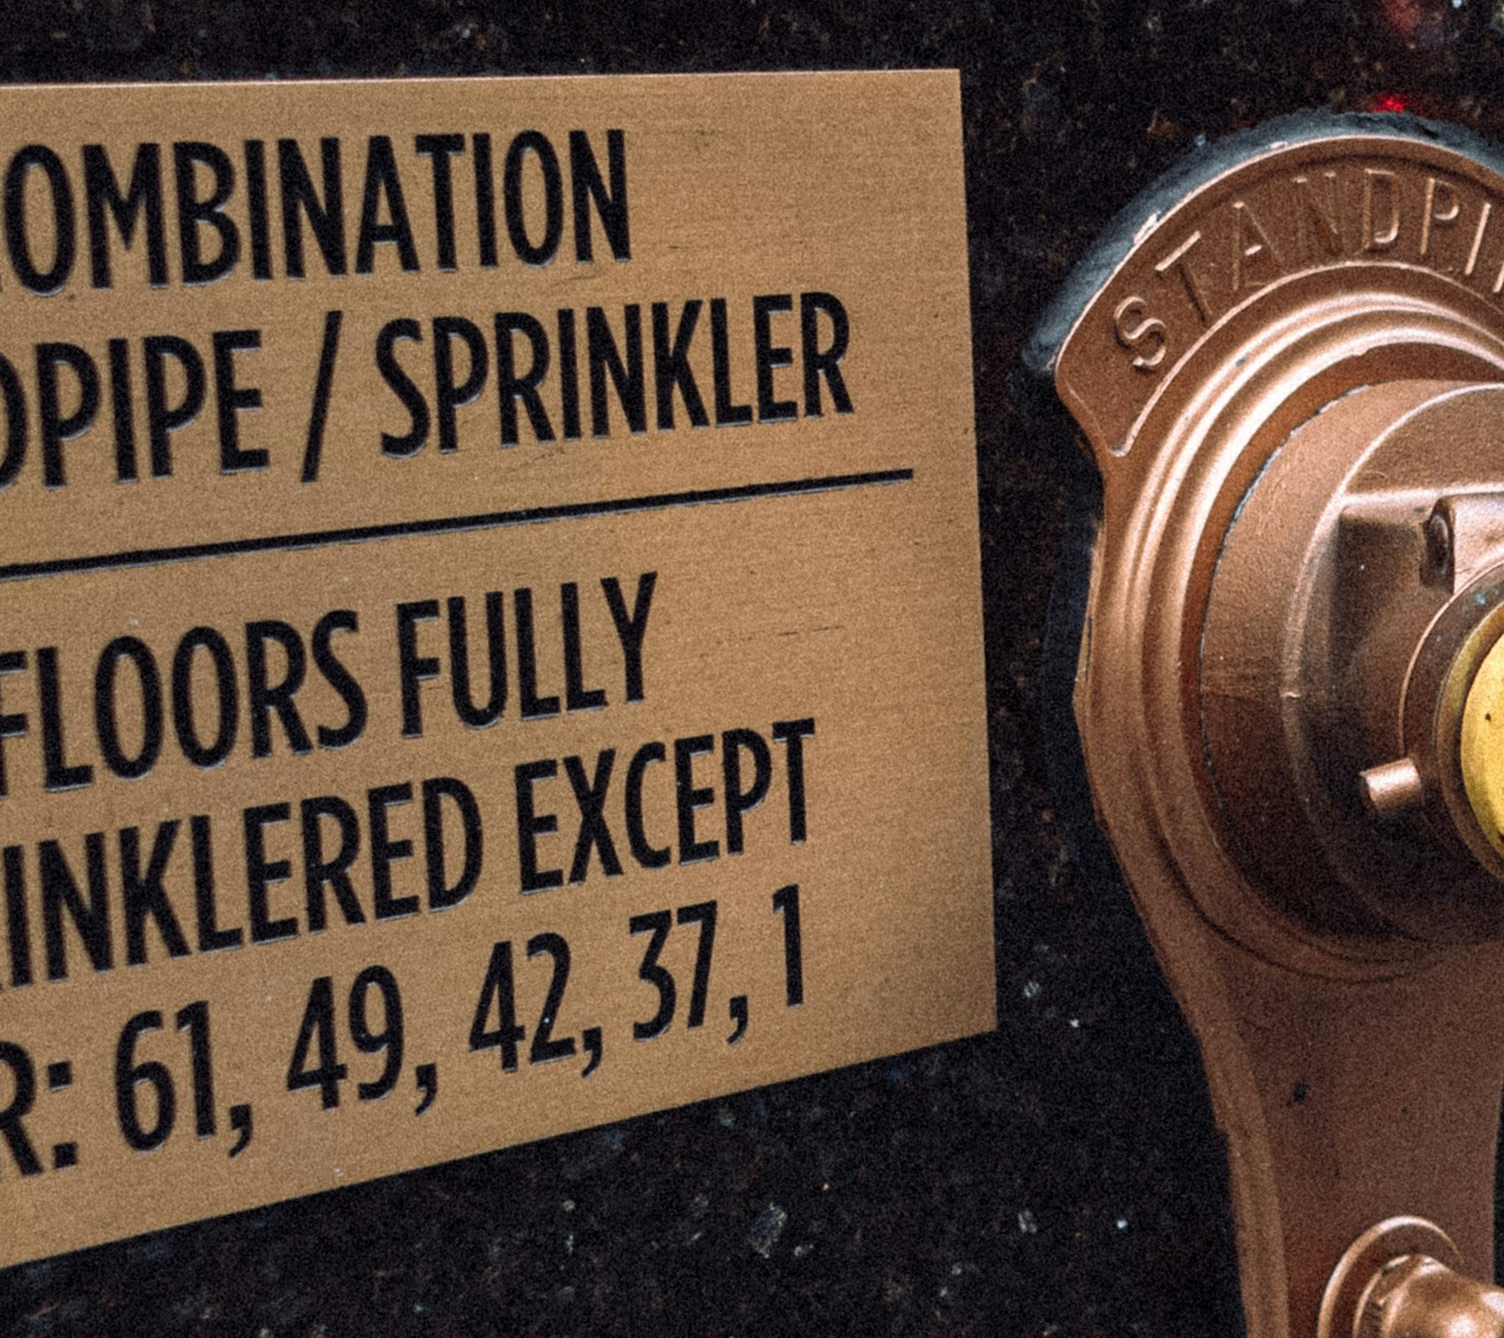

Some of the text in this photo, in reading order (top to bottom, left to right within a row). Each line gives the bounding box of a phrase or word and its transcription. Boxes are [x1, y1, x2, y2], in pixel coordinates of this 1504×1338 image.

[372, 288, 857, 459] SPRINKLER
[393, 568, 661, 739] FULLY
[511, 714, 818, 895] EXCEPT
[111, 997, 256, 1161] 61,
[283, 962, 441, 1119] 49,
[465, 929, 606, 1081] 42,
[626, 897, 752, 1047] 37,
[769, 881, 807, 1010] 1
